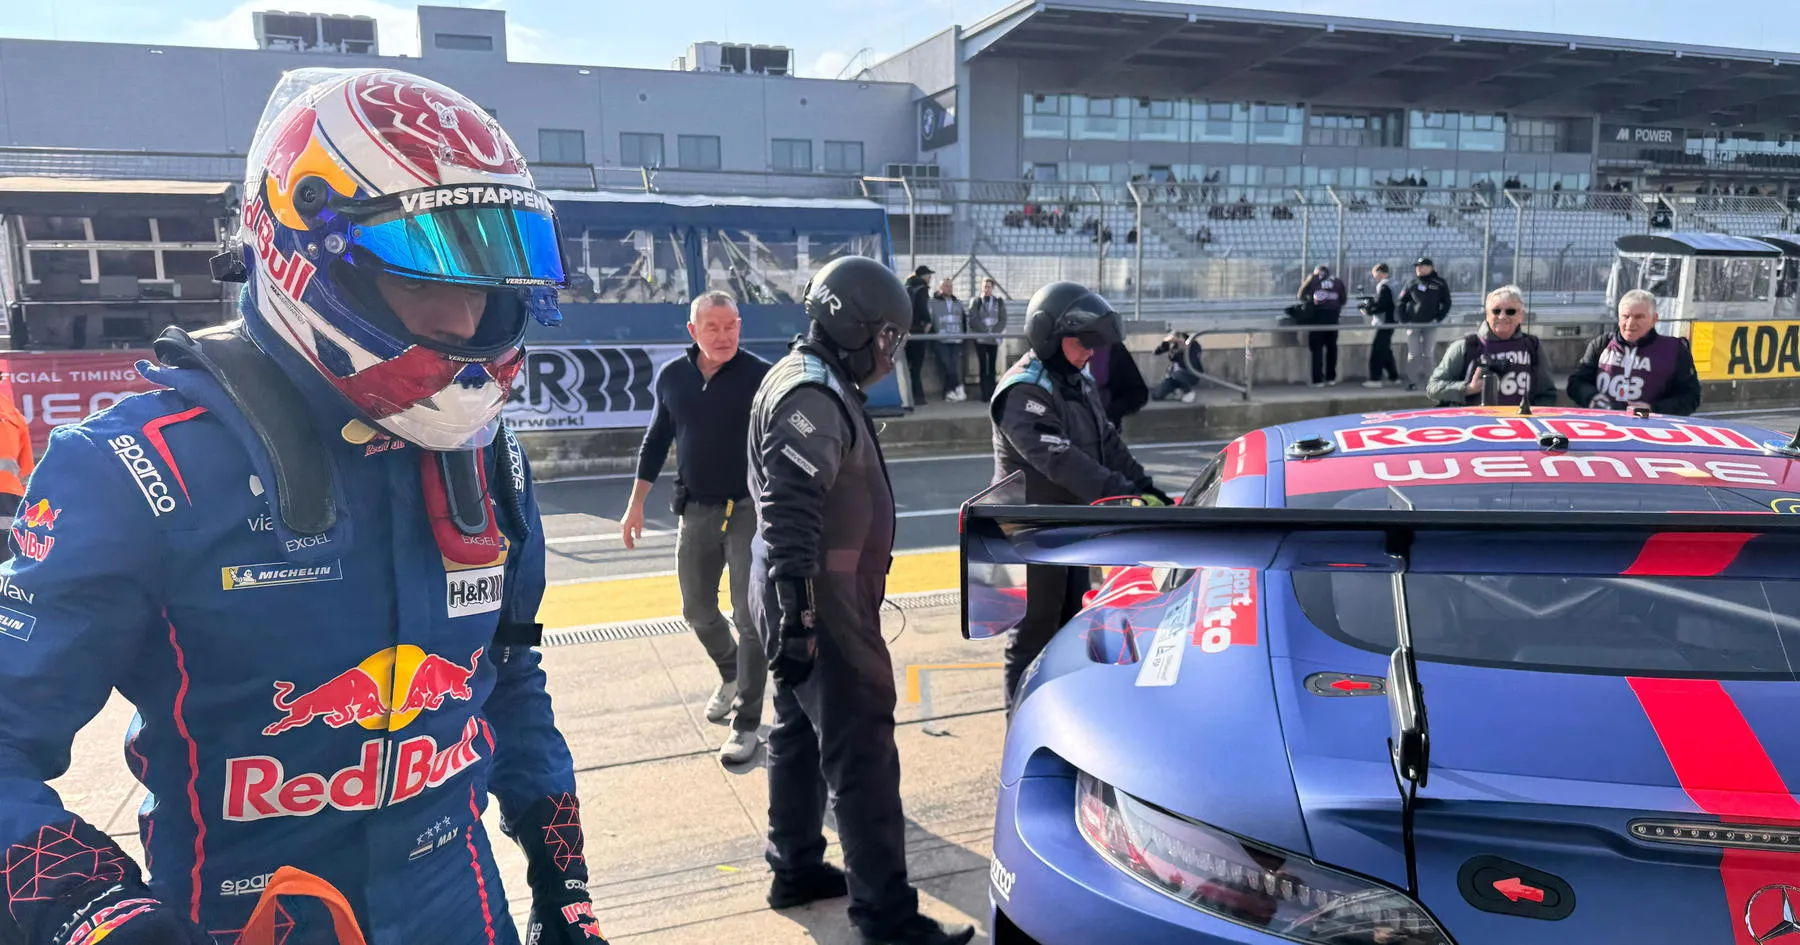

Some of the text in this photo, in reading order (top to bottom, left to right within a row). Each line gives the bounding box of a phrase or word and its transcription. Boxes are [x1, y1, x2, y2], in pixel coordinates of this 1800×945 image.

[1635, 129, 1672, 143] POWER
[256, 209, 317, 302] Bull
[69, 369, 136, 382] TIMING
[1334, 418, 1768, 452] Red Bull
[107, 434, 176, 517] sparco
[1373, 456, 1777, 485] WEMPE
[285, 533, 332, 552] EXGEL
[462, 534, 496, 546] EXGEL
[258, 566, 331, 580] MICHELIN
[449, 576, 490, 608] H&R
[223, 715, 481, 821] Red Bull
